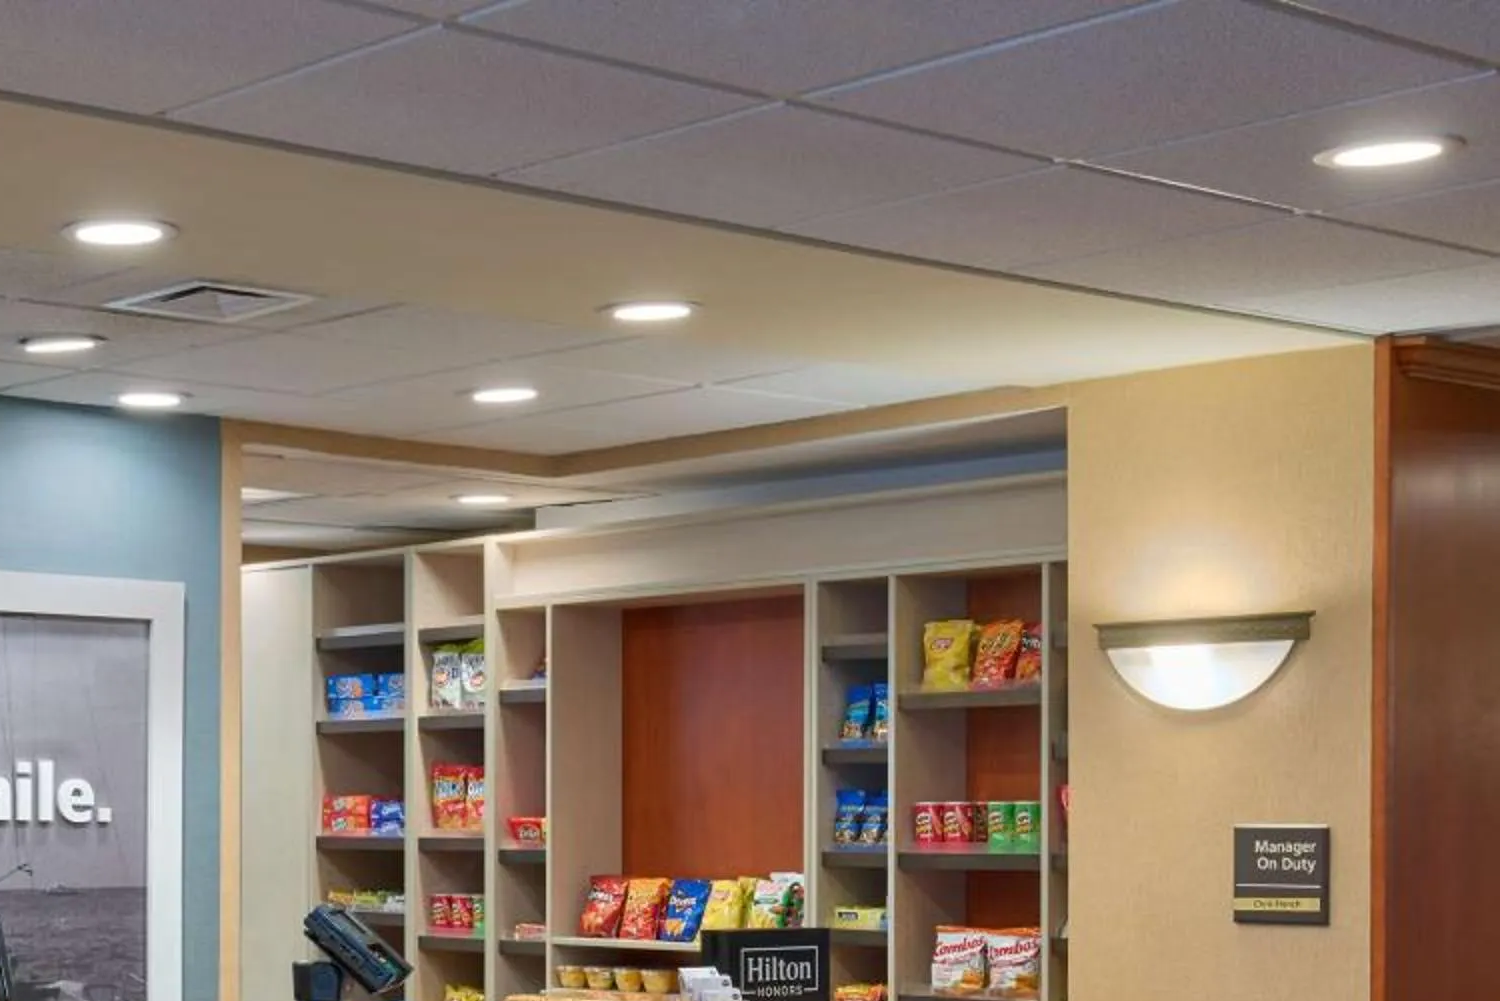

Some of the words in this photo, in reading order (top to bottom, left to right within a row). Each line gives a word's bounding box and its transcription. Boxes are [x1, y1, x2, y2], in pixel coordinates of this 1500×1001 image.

[1254, 840, 1317, 856] Manager
[1257, 857, 1277, 870] On
[1281, 858, 1316, 874] Duty
[747, 957, 812, 982] Hilton
[758, 985, 803, 997] HONORS
